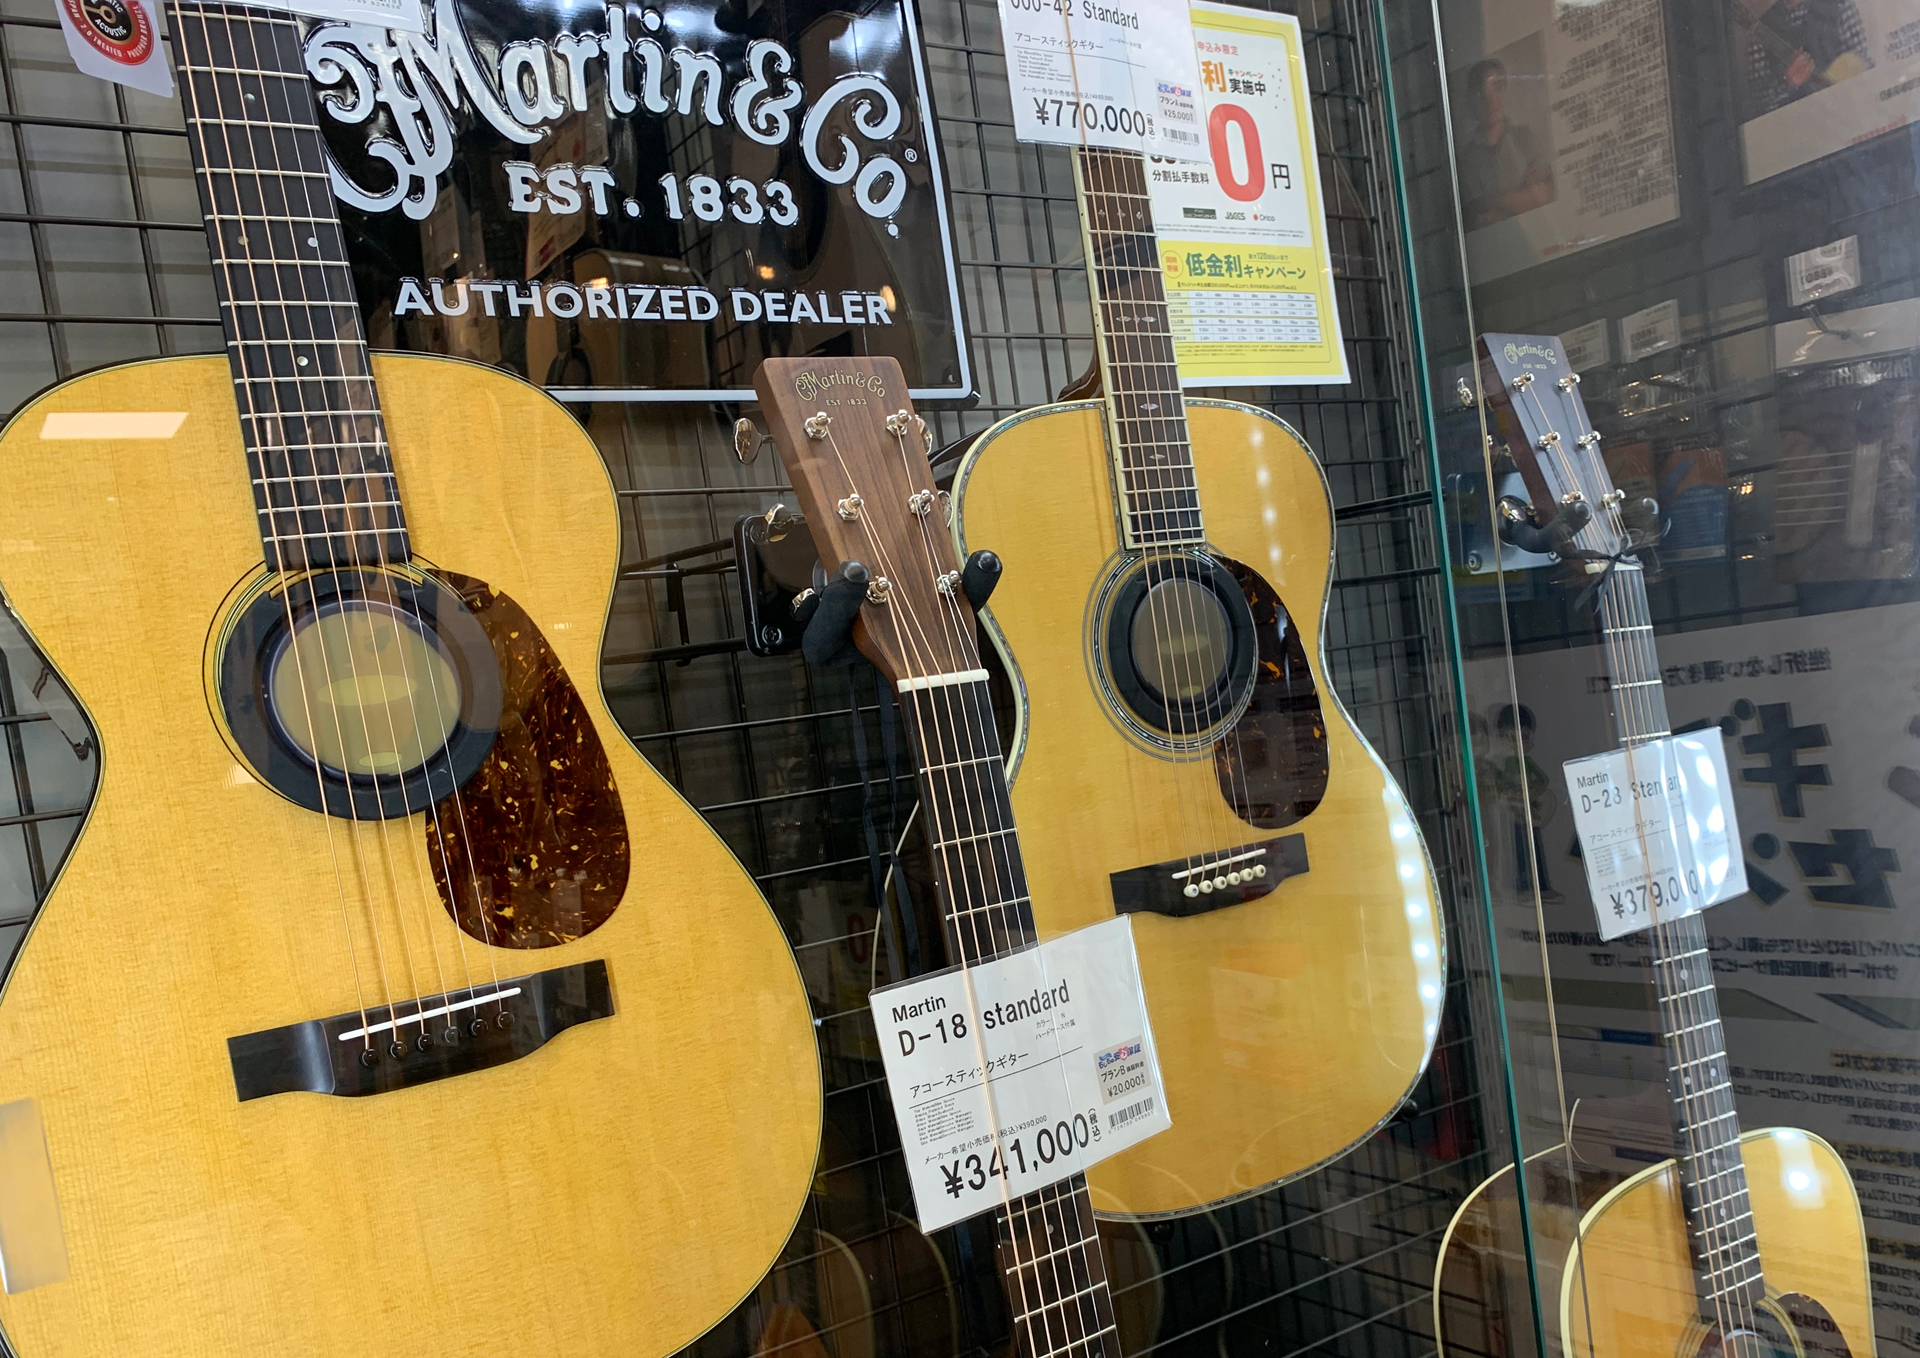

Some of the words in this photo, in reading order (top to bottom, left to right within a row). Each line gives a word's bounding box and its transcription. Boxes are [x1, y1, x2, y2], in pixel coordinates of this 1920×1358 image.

[95, 18, 127, 37] ACOUSTIC
[1083, 1, 1139, 30] Standard
[93, 36, 122, 57] TREATED
[1015, 32, 1103, 50] アコースティックギター
[1201, 61, 1226, 93] 利
[1230, 78, 1266, 96] 実施中
[1033, 97, 1145, 137] ¥770,000
[1152, 170, 1209, 184] 分割払手数料
[1271, 163, 1291, 190] 円
[504, 161, 642, 218] EST.
[660, 173, 800, 226] 1833
[395, 278, 719, 322] AUTHORIZED
[734, 290, 893, 326] DEALER
[795, 369, 854, 401] Martin
[1577, 771, 1609, 789] Martin
[1581, 786, 1622, 814] D-28
[1631, 774, 1682, 800] Stanar
[1610, 870, 1699, 919] ¥379,00
[892, 995, 946, 1023] Martin
[898, 1013, 967, 1057] D-18
[984, 979, 1070, 1030] standard
[1035, 1019, 1076, 1040] ハードケース付属
[909, 1052, 1028, 1098] アコースティックギター
[1107, 1075, 1140, 1097] ¥20,000
[940, 1113, 1089, 1199] ¥341,000
